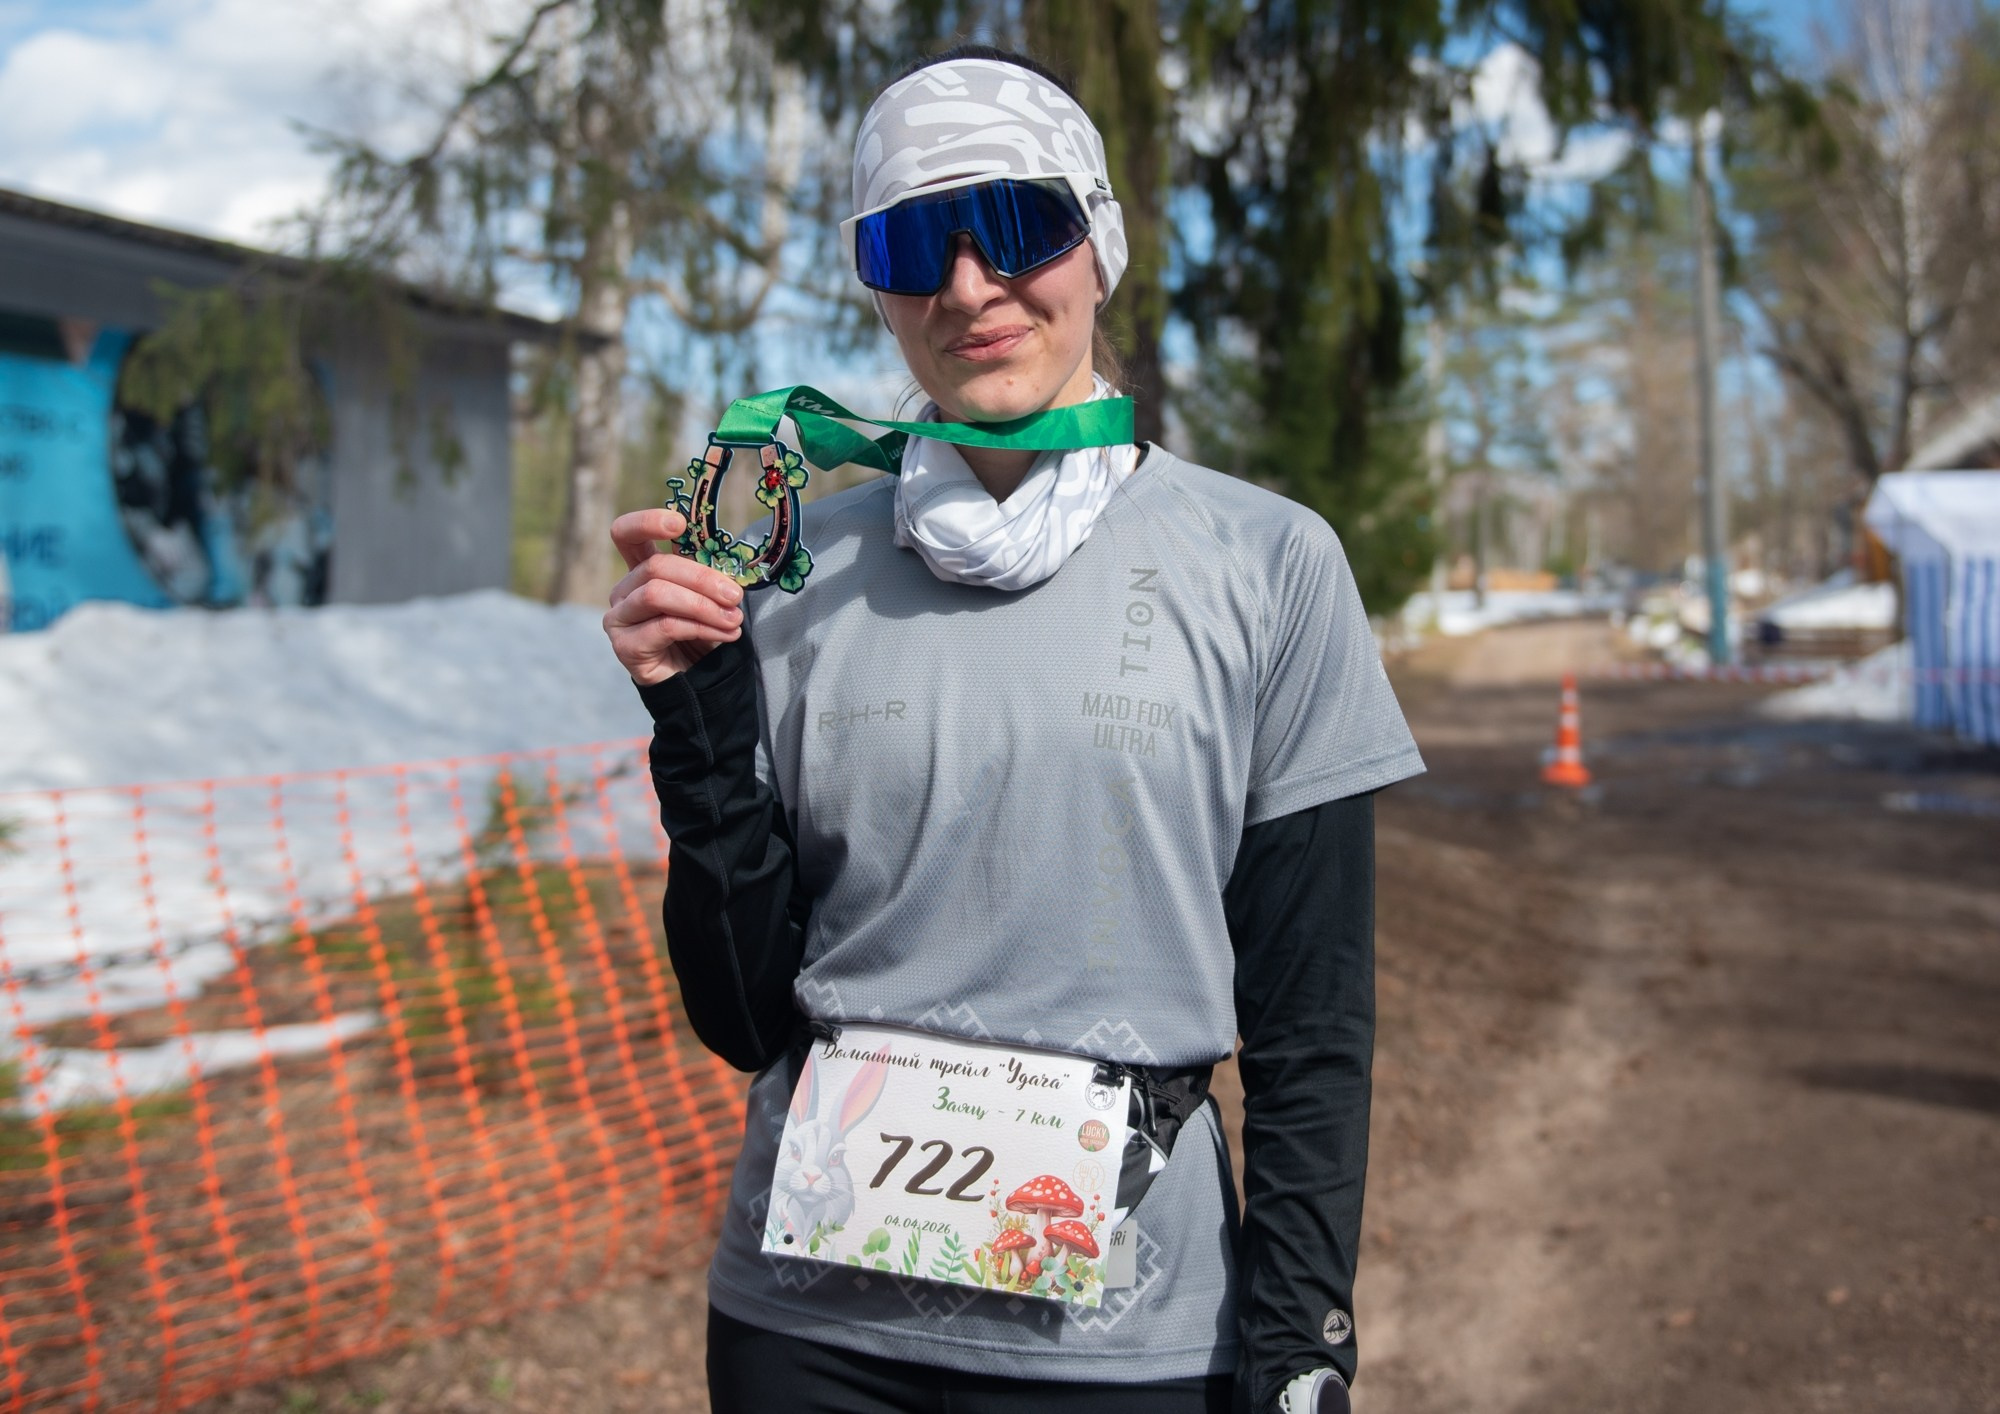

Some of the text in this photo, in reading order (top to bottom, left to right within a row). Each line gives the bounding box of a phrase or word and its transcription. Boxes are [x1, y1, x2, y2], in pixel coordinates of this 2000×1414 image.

[1081, 692, 1176, 731] MAD FOX
[1093, 722, 1156, 758] ULTRA
[819, 1042, 923, 1069] Домашний
[929, 1058, 991, 1079] трейл
[1015, 1109, 1026, 1122] 7
[1030, 1111, 1066, 1129] км
[1081, 1124, 1107, 1139] LUCKY
[869, 1132, 995, 1202] 722
[884, 1214, 951, 1235] 04.04.2026
